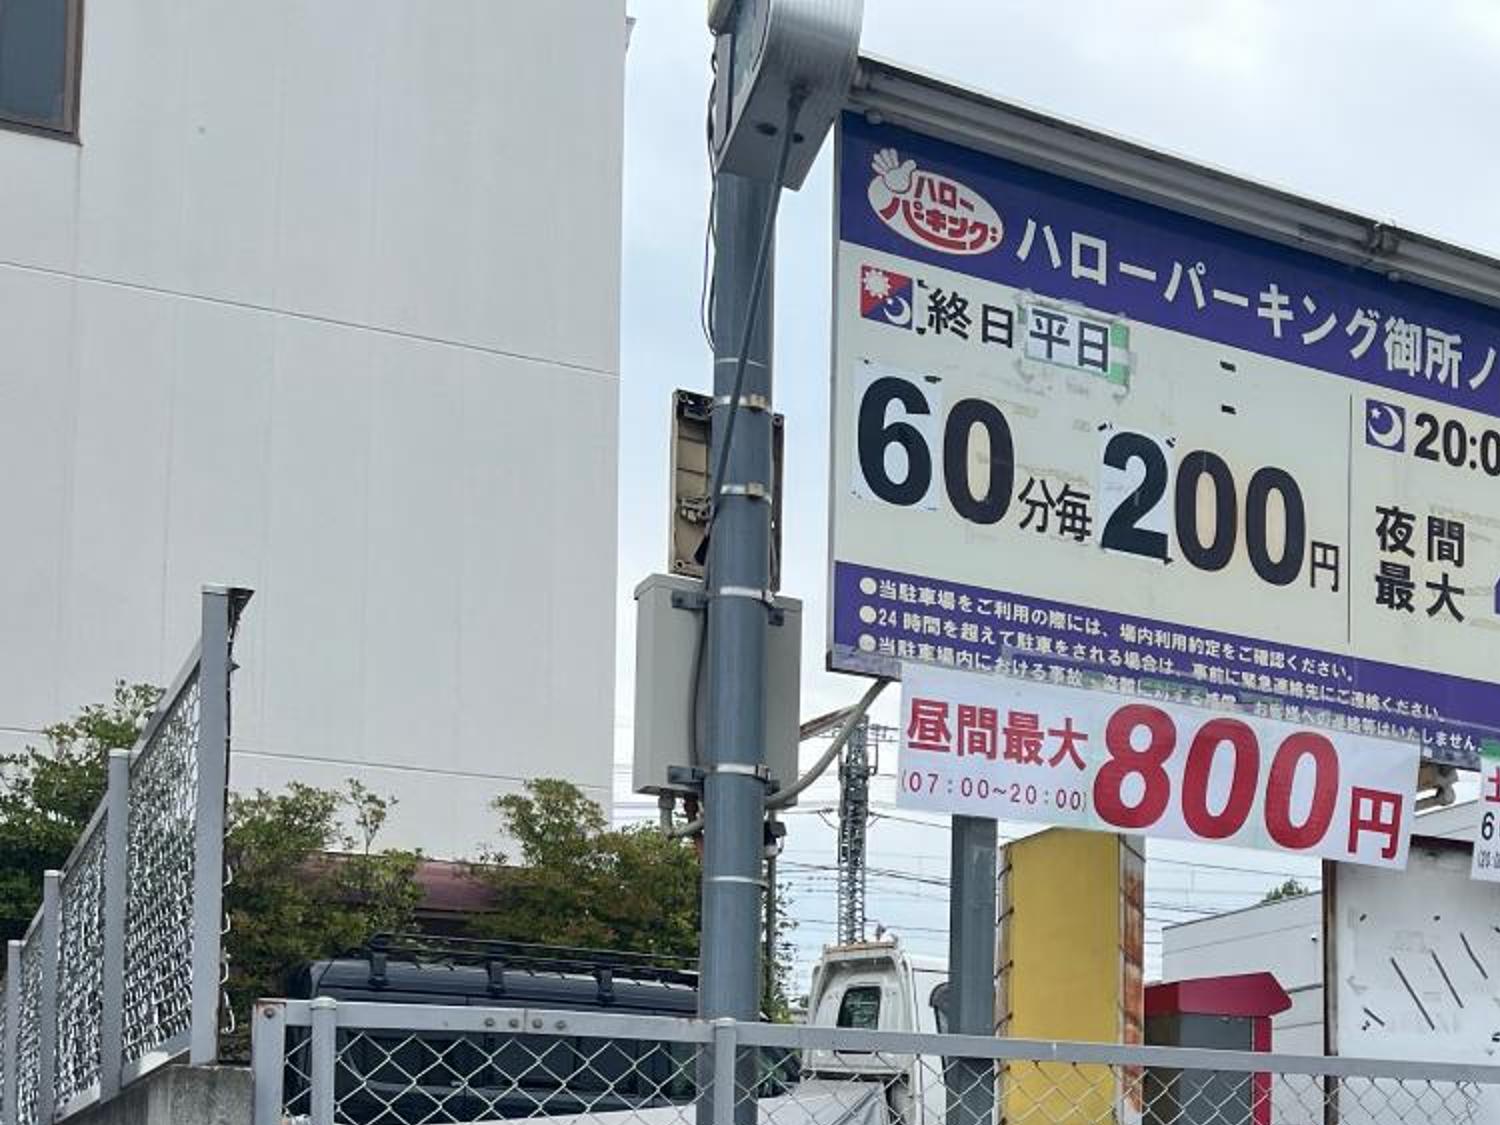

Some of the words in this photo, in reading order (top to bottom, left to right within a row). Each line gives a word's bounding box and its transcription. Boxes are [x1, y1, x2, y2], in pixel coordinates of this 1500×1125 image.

[914, 176, 975, 212] ハロー
[927, 288, 1014, 350] 終日
[1029, 307, 1110, 373] 平日
[907, 697, 1088, 772] 昼間最大
